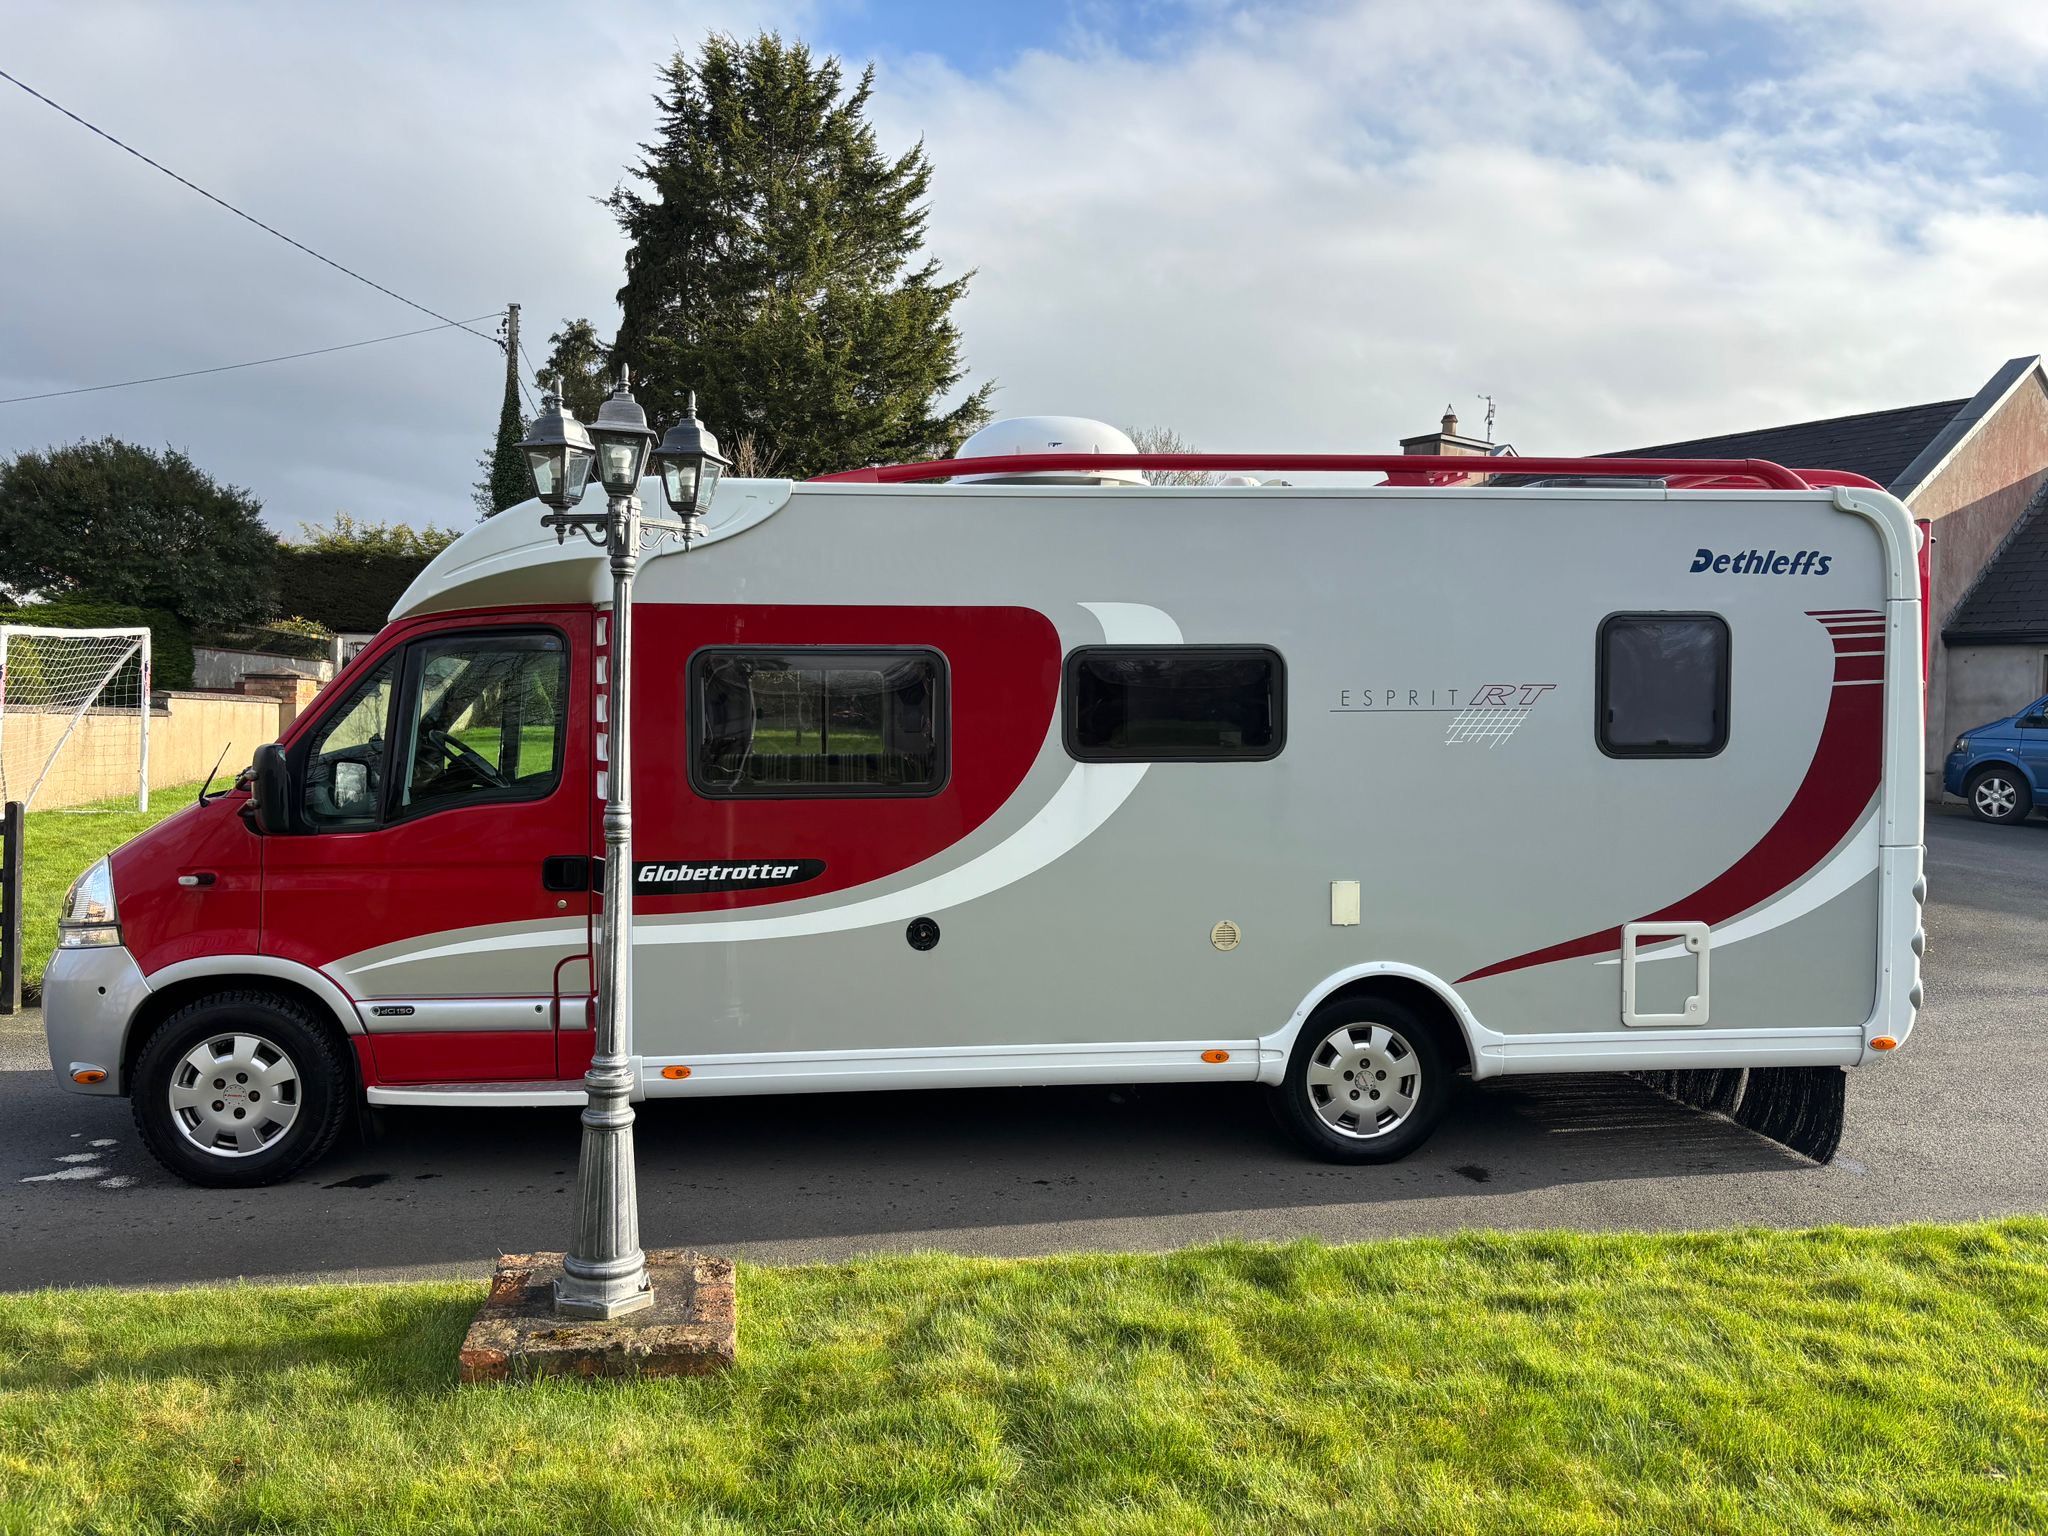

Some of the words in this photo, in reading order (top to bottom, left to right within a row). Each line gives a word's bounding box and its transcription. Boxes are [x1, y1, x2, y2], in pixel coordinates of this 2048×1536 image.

[1690, 549, 1832, 575] Dethleffs
[1341, 689, 1458, 706] ESPRIT
[1469, 684, 1557, 706] RT
[638, 864, 799, 882] Globetrotter
